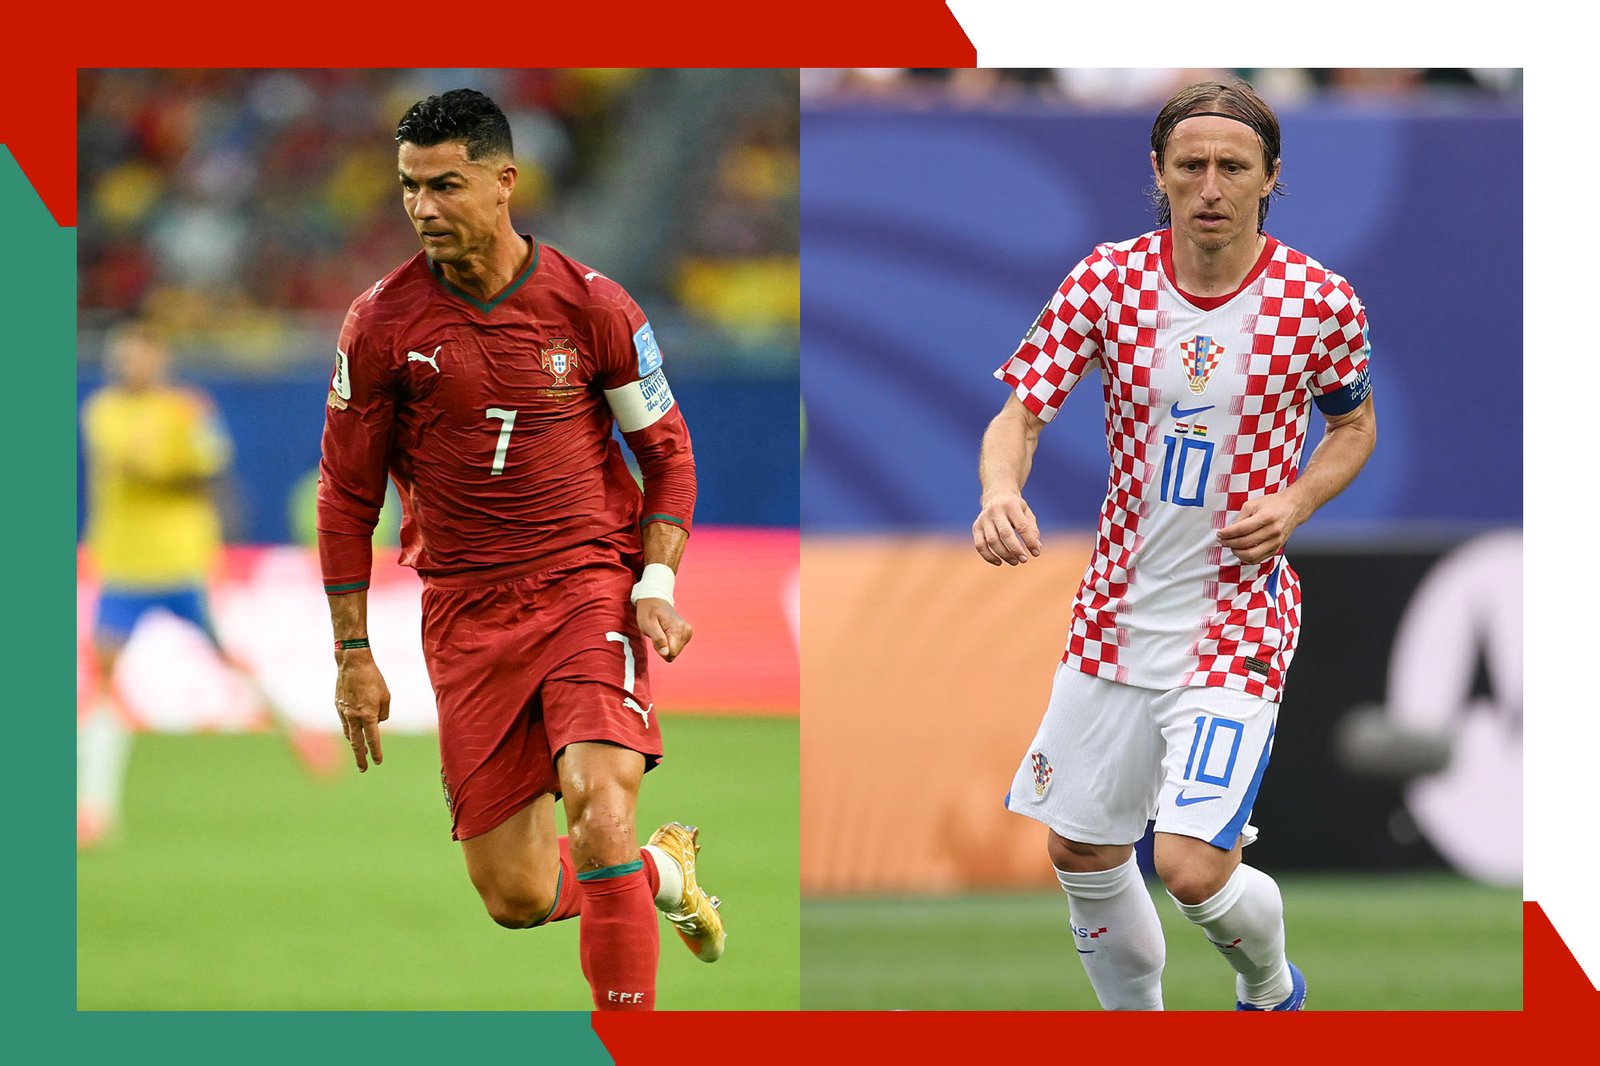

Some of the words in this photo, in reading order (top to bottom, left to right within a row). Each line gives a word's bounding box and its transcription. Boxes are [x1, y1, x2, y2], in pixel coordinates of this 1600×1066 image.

[1196, 339, 1207, 371] HNS
[485, 408, 518, 475] 7
[1160, 434, 1215, 507] 10
[605, 631, 635, 694] 7
[1183, 716, 1245, 788] 10
